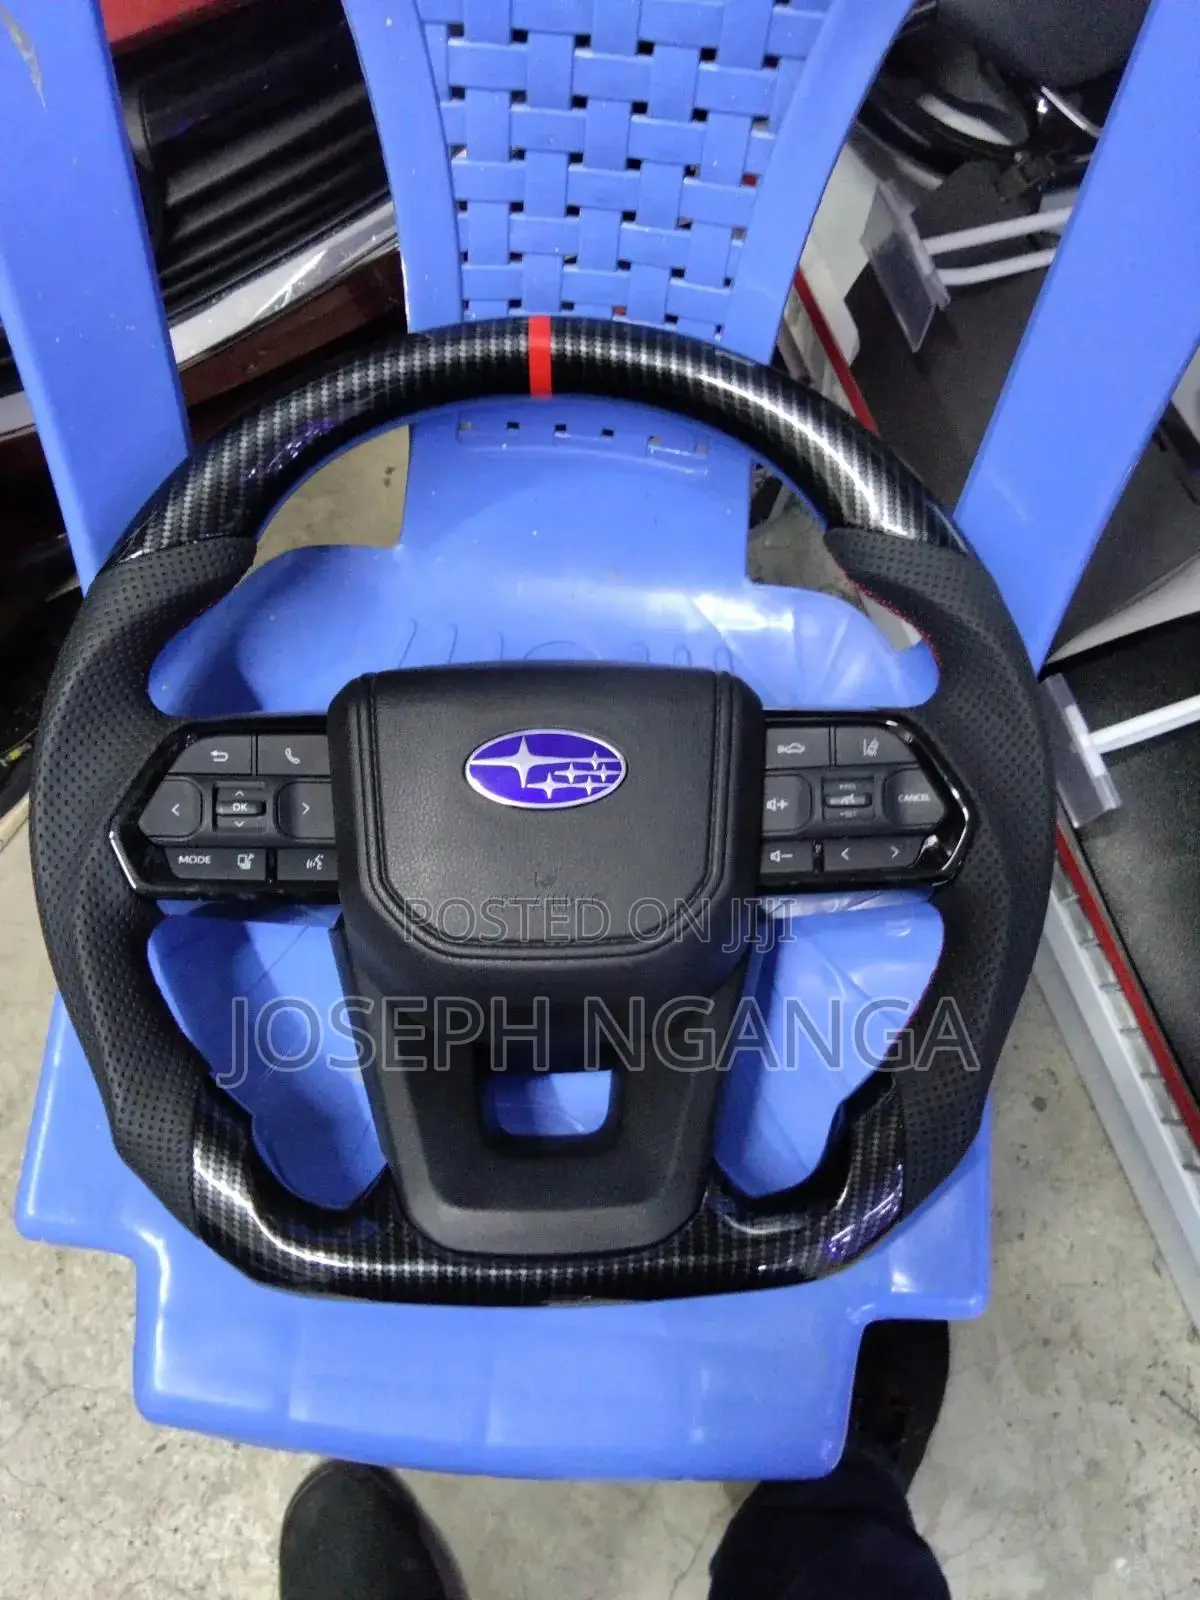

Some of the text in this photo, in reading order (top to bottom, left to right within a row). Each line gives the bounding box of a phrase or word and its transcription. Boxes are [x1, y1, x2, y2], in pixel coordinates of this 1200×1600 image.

[898, 792, 931, 802] CANCEL
[232, 802, 248, 812] OK
[178, 855, 212, 864] MODE
